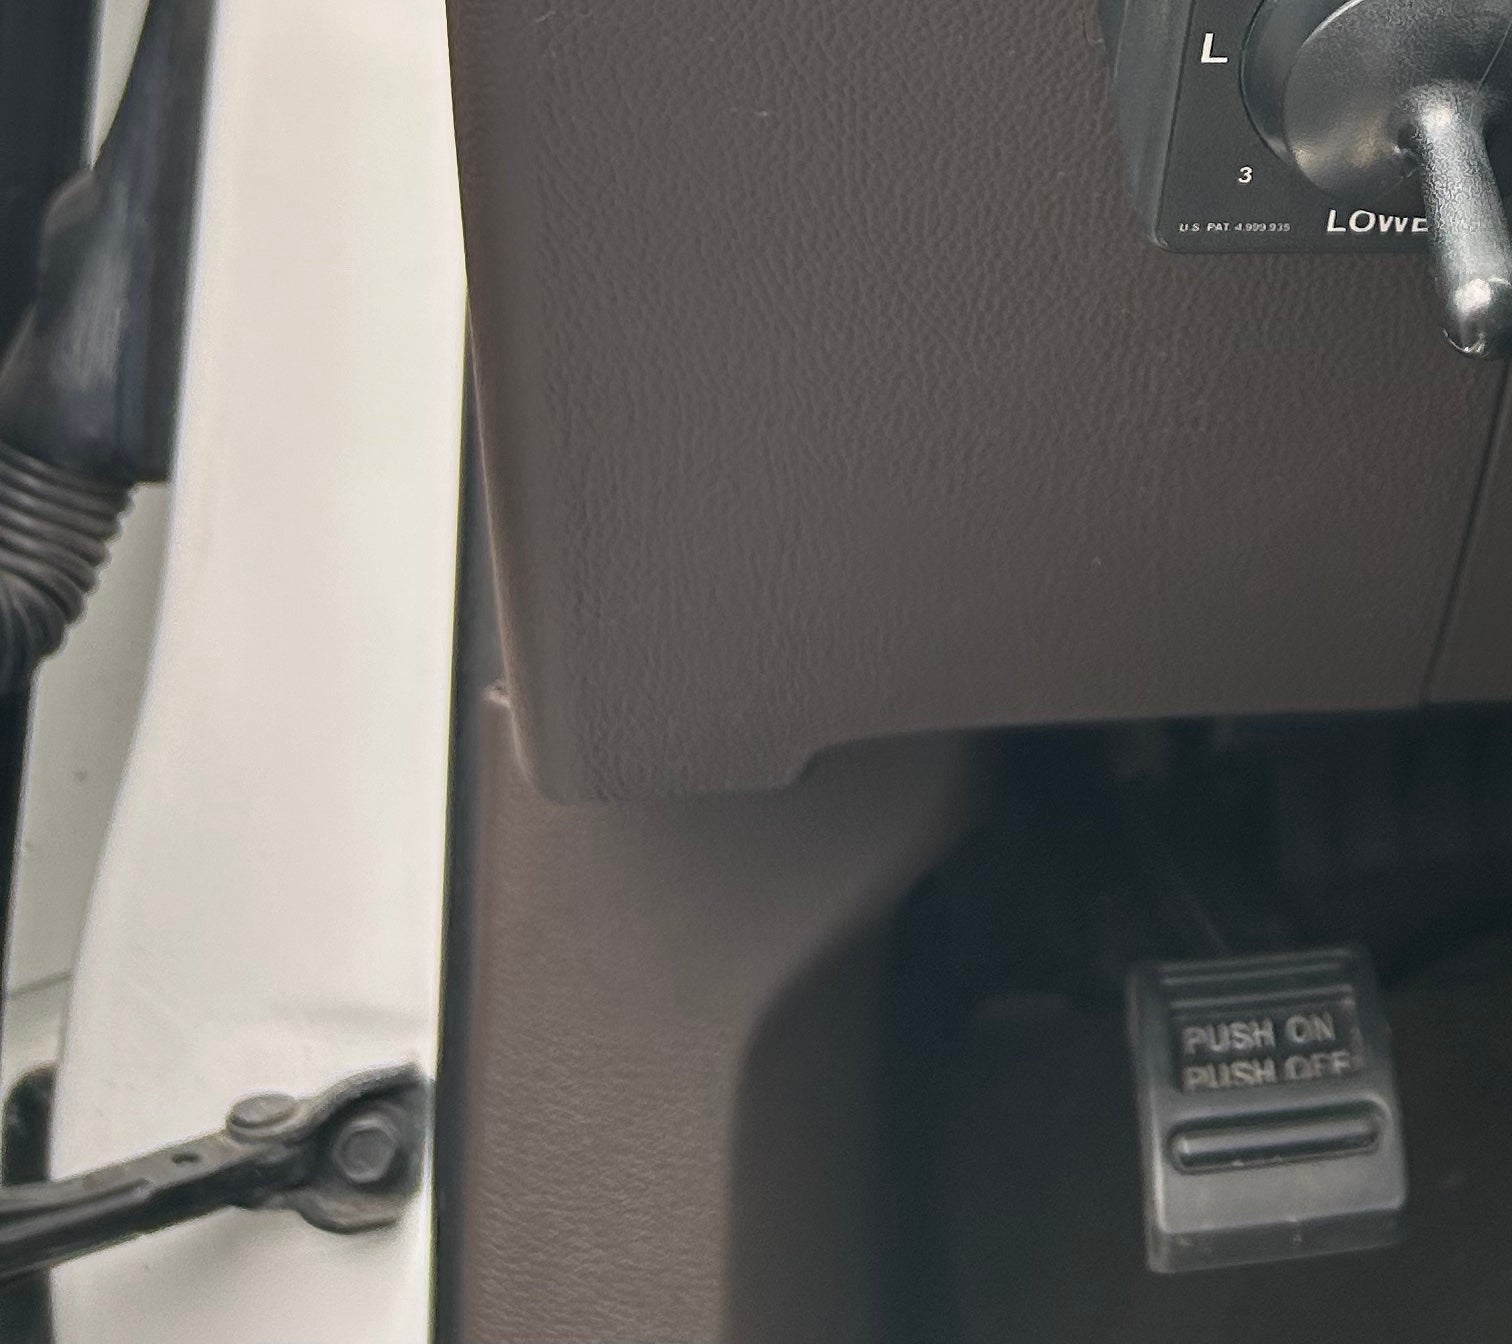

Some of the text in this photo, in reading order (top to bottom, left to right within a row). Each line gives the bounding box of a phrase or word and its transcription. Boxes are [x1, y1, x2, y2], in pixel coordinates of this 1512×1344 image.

[1200, 32, 1229, 65] L
[1237, 166, 1253, 184] 3
[1327, 209, 1429, 233] LOWE
[1182, 1012, 1337, 1055] PUSH ON
[1182, 1050, 1351, 1092] PUSH OFF
